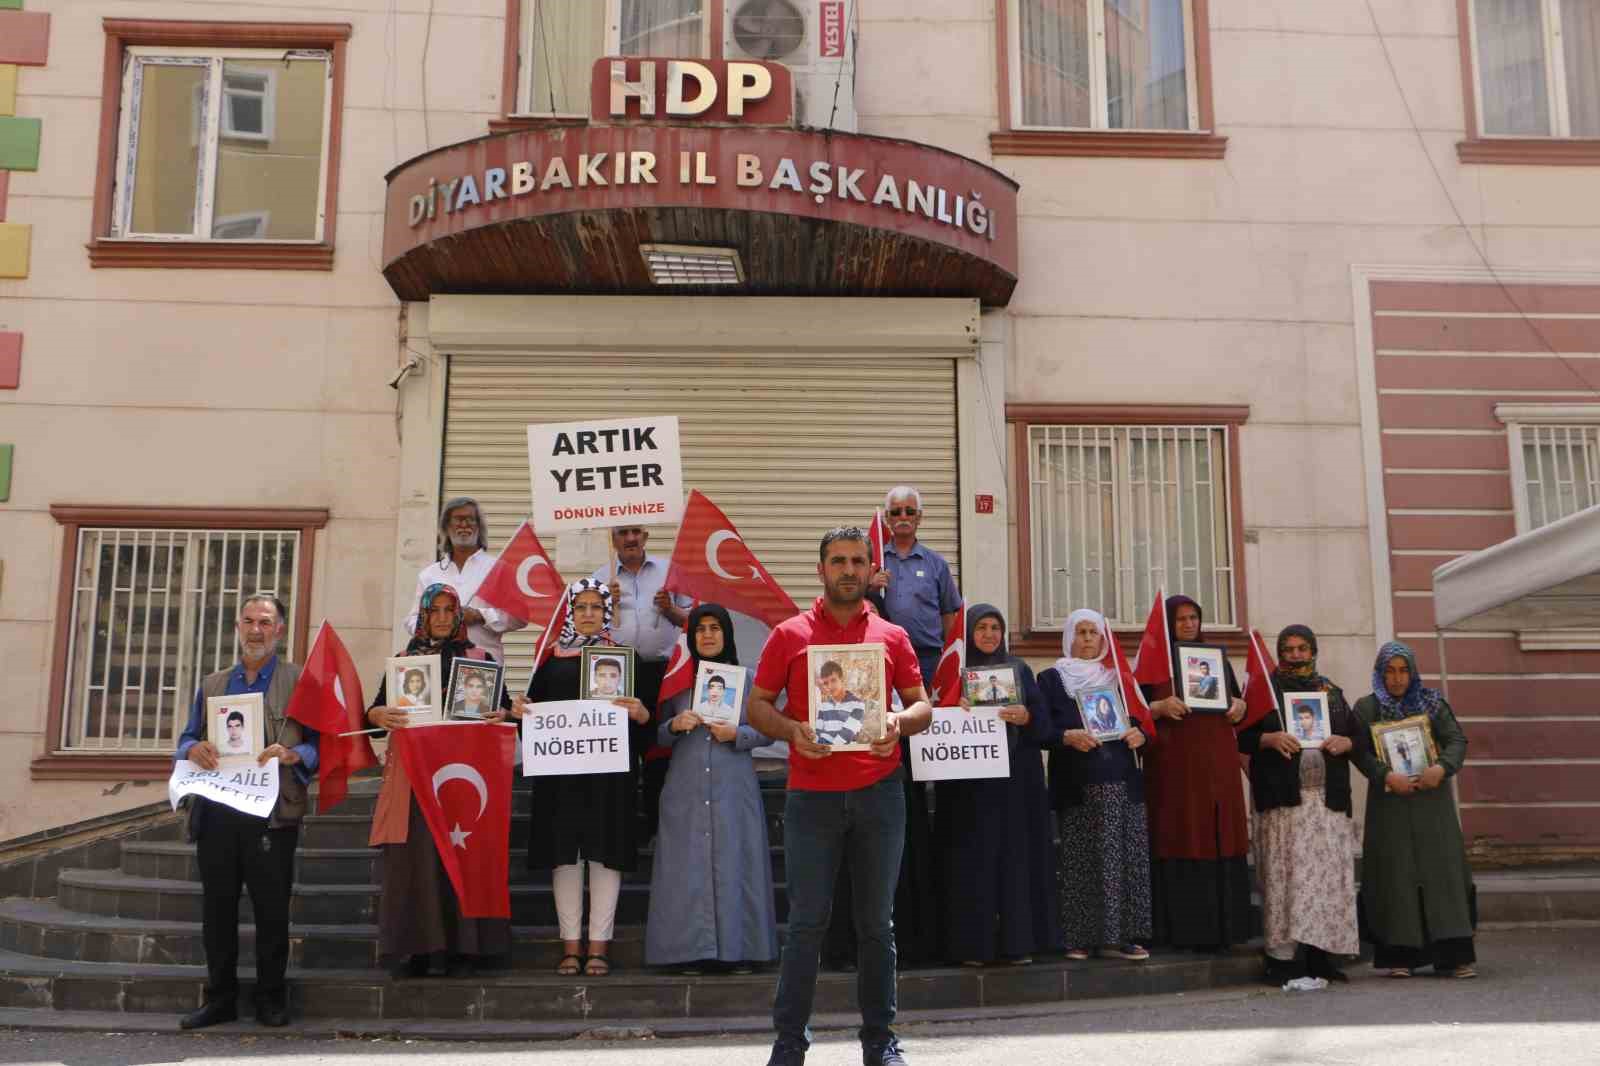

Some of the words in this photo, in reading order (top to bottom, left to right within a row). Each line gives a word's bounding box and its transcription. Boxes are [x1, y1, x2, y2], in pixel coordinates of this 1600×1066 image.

[824, 1, 840, 57] VESTEL
[610, 60, 772, 117] HDP
[736, 153, 996, 241] BAŞKANLIĞI
[552, 426, 658, 456] ARTIK
[550, 463, 664, 492] YETER
[609, 501, 665, 517] EVİNİZE
[534, 713, 573, 730] 360.
[578, 708, 617, 728] AİLE
[961, 715, 997, 735] AİLE
[533, 736, 619, 757] NÖBETTE
[921, 741, 1000, 762] NÖBETTE
[229, 768, 270, 787] AİLE
